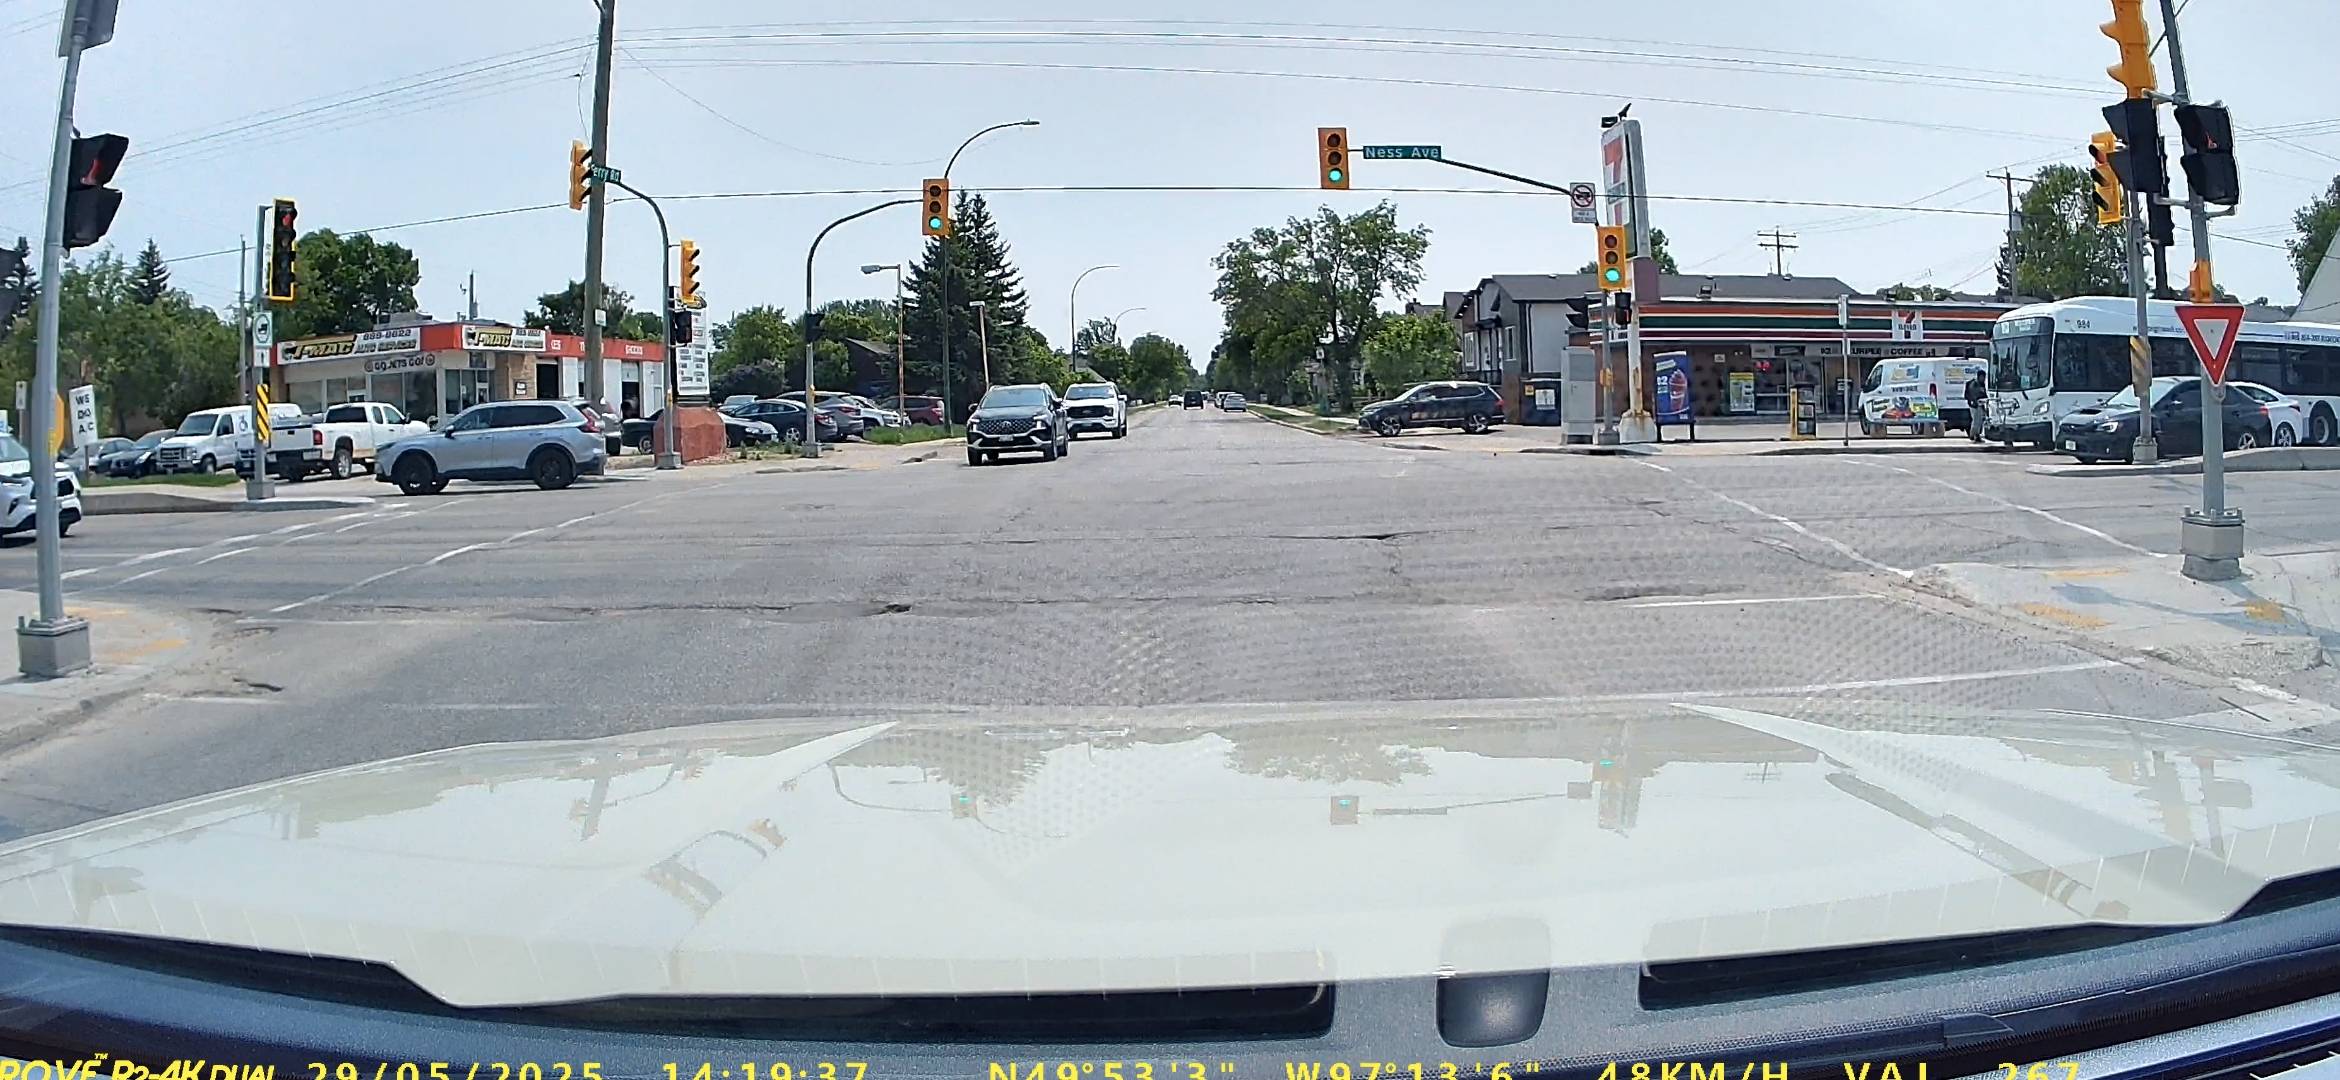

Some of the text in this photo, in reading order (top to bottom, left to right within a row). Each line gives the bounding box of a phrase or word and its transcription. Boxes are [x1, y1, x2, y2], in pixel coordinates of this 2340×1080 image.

[1365, 146, 1440, 158] Ness Ave
[75, 394, 91, 405] WE
[77, 408, 91, 420] DO
[78, 421, 94, 434] A C
